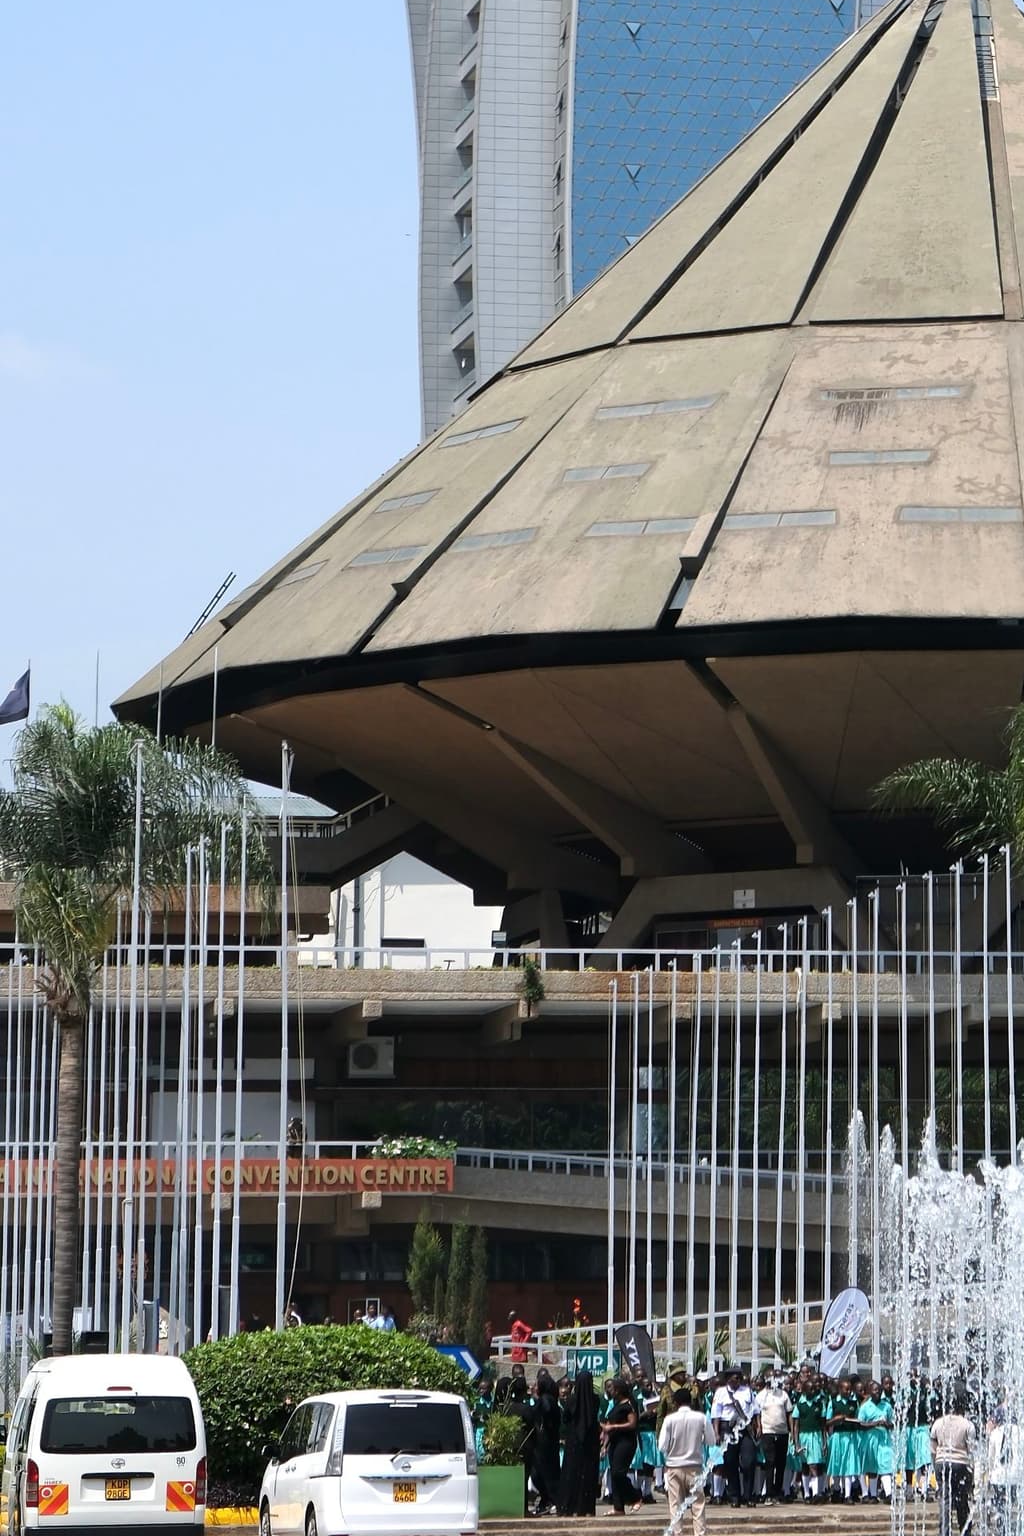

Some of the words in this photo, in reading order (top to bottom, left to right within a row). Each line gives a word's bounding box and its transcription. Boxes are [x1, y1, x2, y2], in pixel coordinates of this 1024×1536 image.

[206, 1166, 355, 1186] CONVENTION
[360, 1165, 446, 1185] CENTRE
[577, 1355, 603, 1369] VIP
[111, 1479, 128, 1489] KDP
